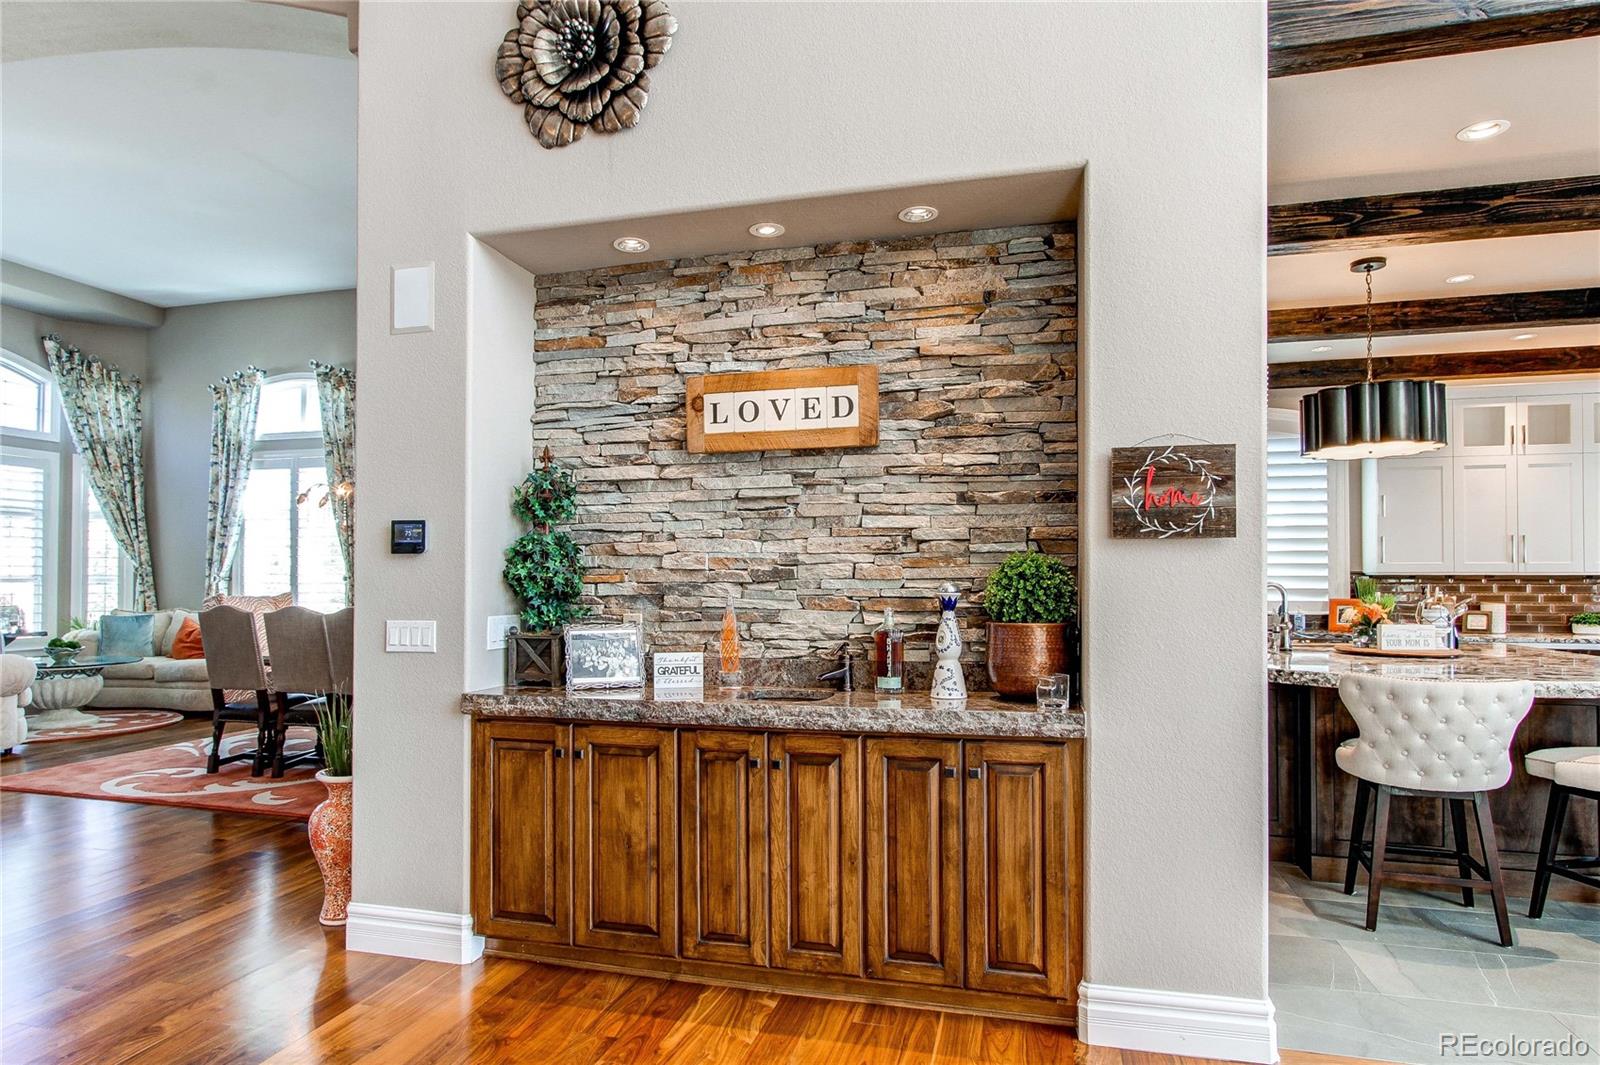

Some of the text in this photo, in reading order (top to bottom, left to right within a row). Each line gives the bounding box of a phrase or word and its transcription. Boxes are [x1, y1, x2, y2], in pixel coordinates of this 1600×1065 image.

[709, 395, 854, 425] LOVED
[1144, 464, 1205, 511] home
[1385, 639, 1430, 647] YOUR MOM IS
[657, 665, 701, 675] GRATEFUL
